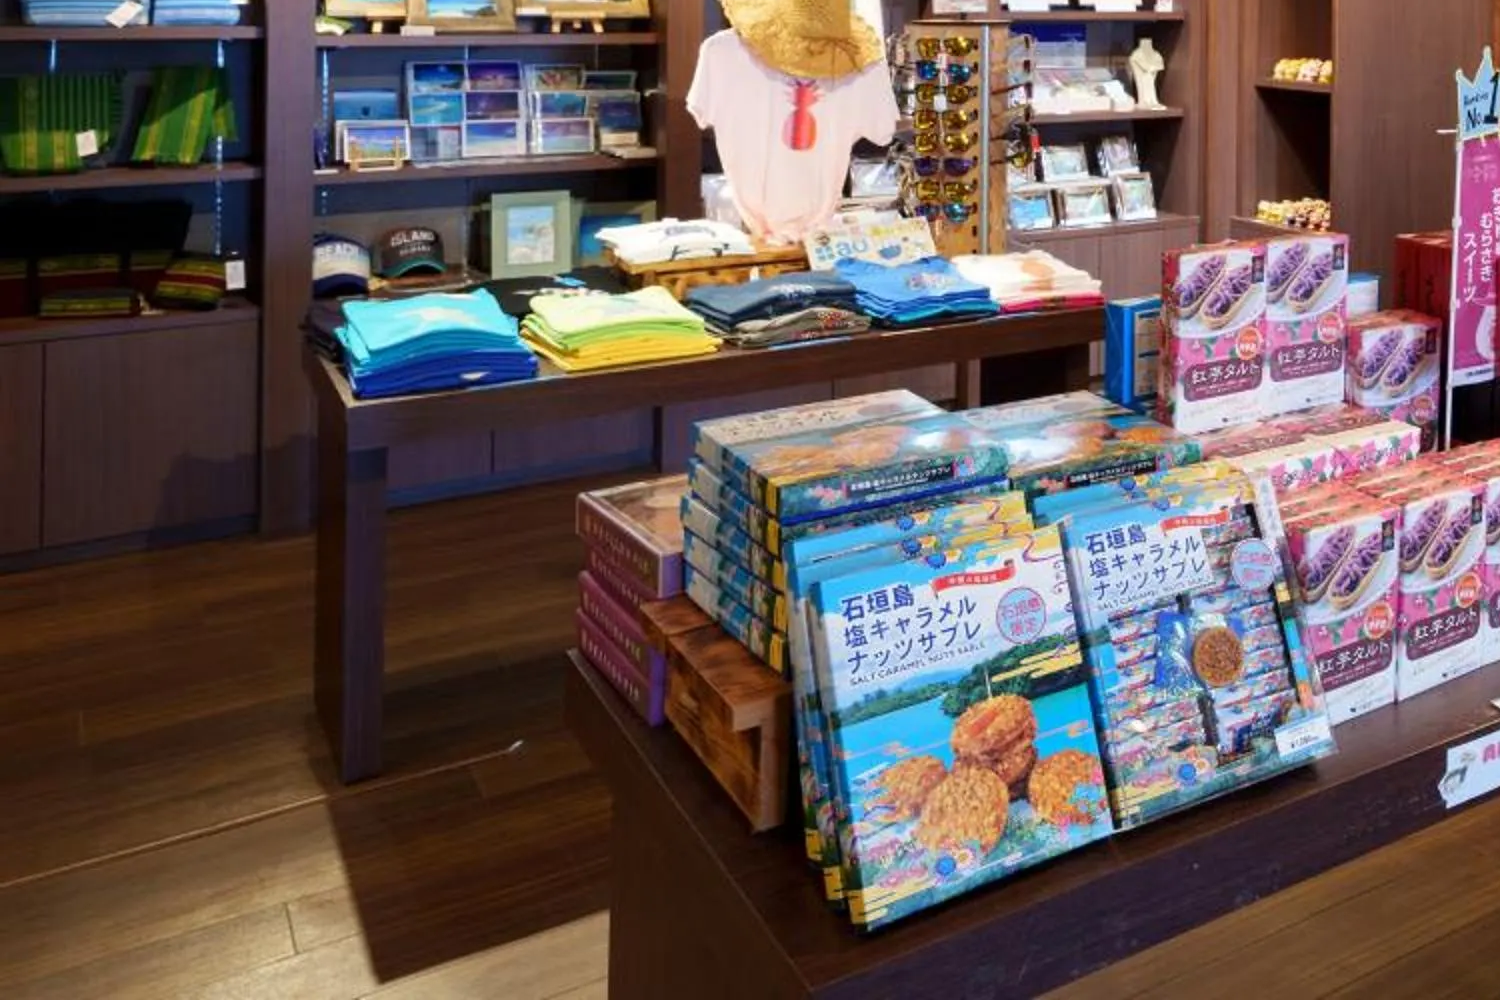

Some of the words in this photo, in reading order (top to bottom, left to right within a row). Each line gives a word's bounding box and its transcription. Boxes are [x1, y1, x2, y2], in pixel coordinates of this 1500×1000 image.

[1463, 233, 1477, 302] スイーツ
[1479, 213, 1494, 282] むらさき
[1085, 523, 1147, 555] 石垣島
[1089, 535, 1201, 578] 塩キャラメル
[842, 584, 915, 622] 石垣島
[845, 596, 977, 648] 塩キャラメル
